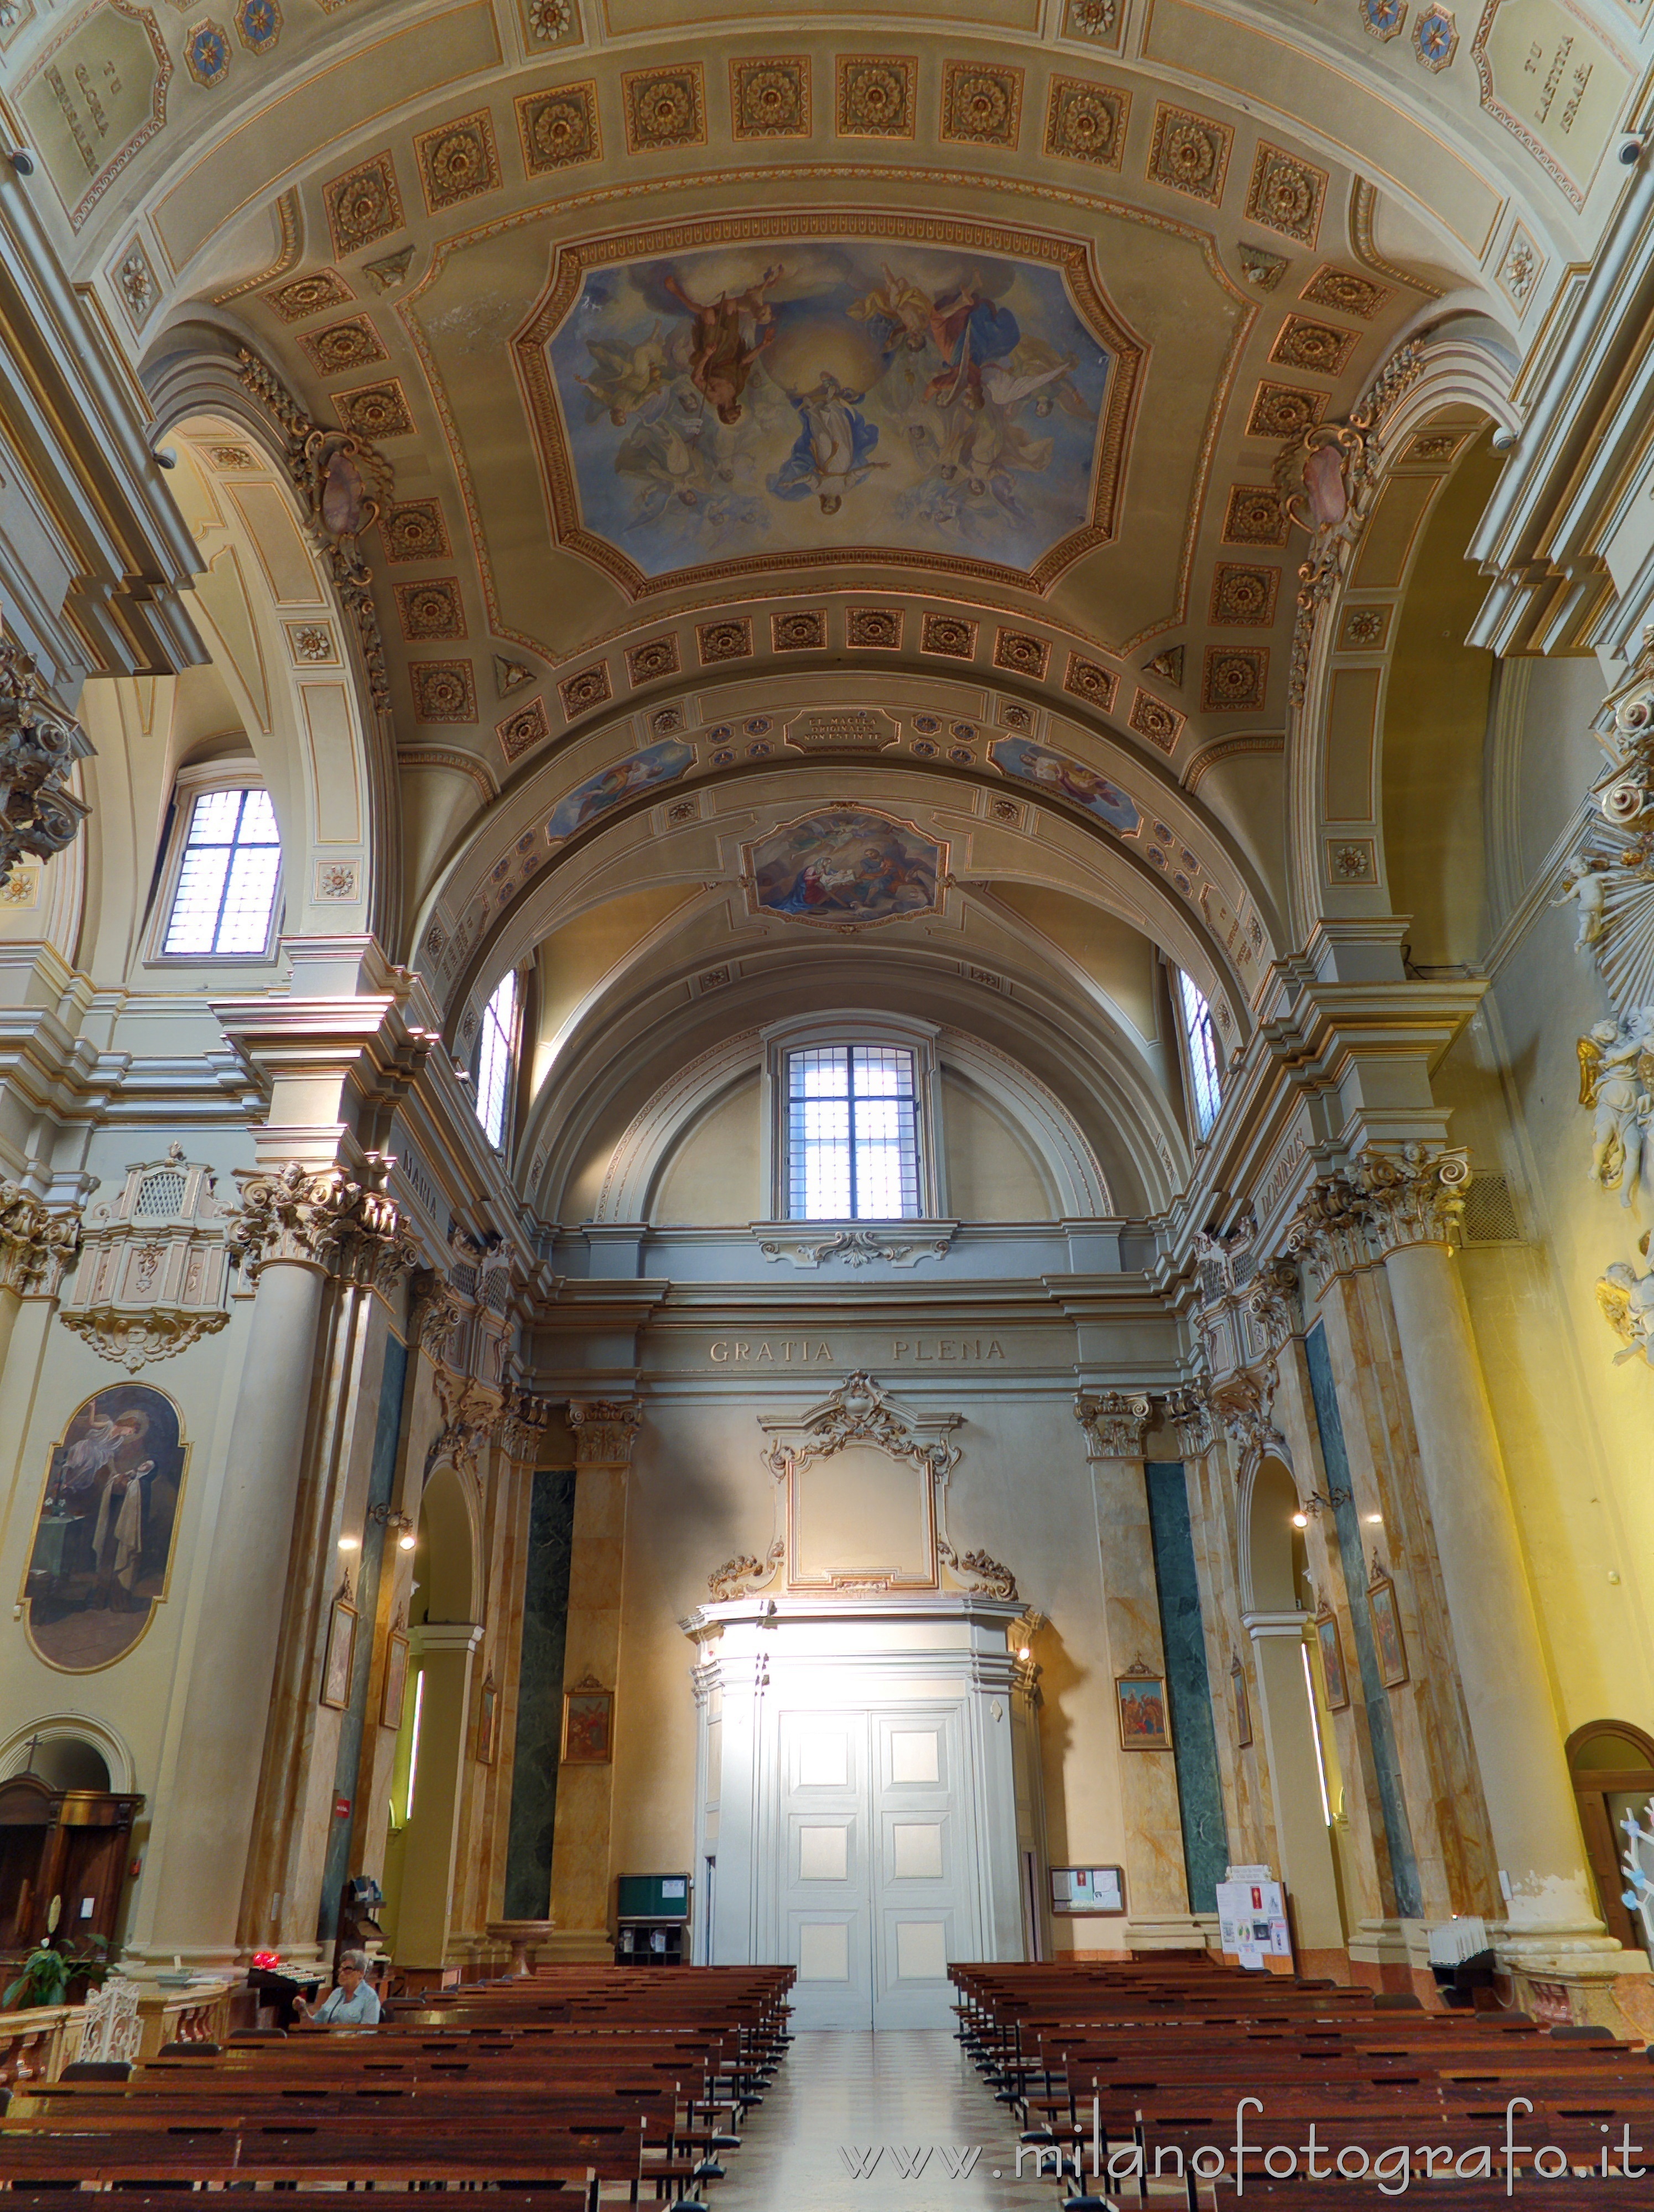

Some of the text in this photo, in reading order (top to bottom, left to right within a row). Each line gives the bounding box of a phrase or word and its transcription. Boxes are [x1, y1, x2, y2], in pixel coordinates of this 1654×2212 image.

[1524, 40, 1542, 74] TU
[103, 60, 122, 95] TU
[809, 716, 877, 725] ET MACULA
[811, 724, 874, 733] ORIGINALIS
[829, 732, 849, 740] EST
[403, 1149, 436, 1221] MARIA
[710, 1339, 1006, 1363] GRATIA PLENA
